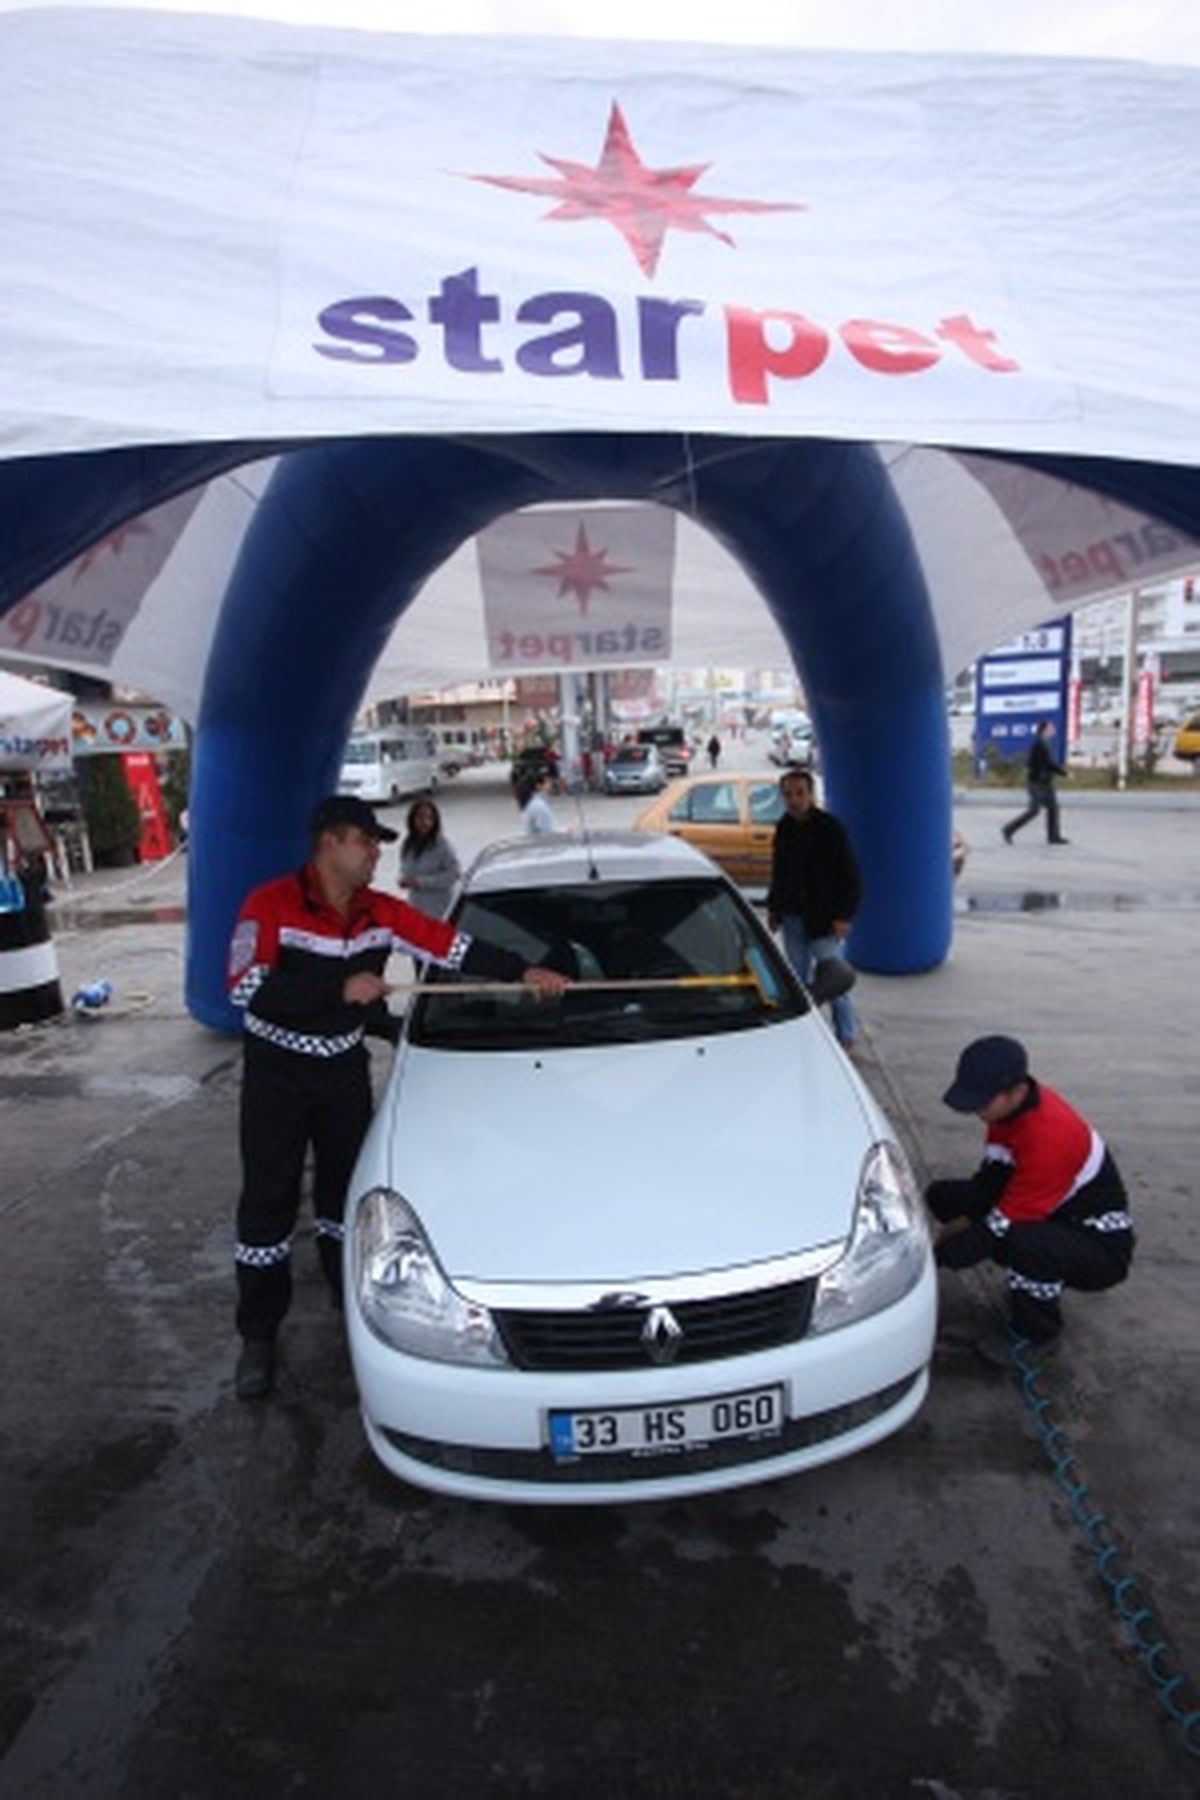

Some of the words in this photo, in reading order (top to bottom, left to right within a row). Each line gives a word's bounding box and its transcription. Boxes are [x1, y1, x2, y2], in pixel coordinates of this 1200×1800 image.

[311, 265, 1021, 406] starpet
[575, 1415, 618, 1449] 33
[643, 1409, 687, 1443] HS
[711, 1395, 774, 1434] 060
